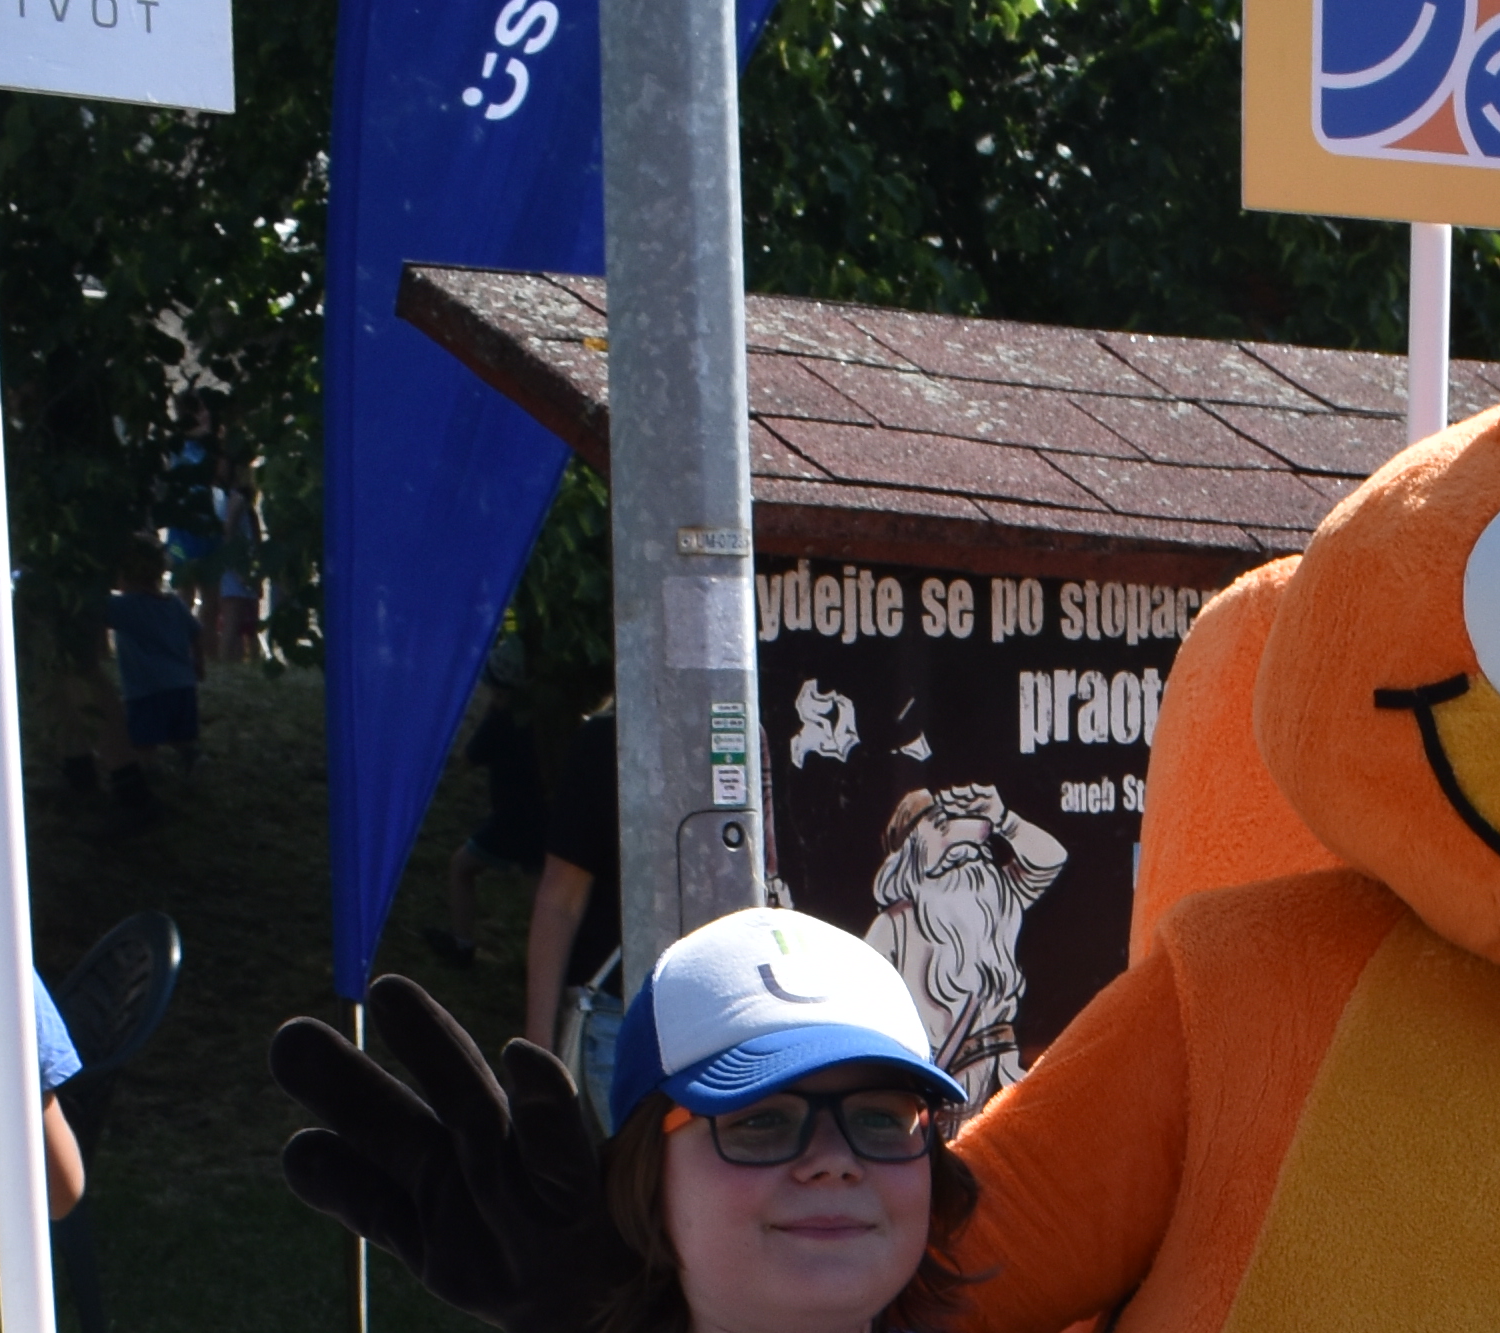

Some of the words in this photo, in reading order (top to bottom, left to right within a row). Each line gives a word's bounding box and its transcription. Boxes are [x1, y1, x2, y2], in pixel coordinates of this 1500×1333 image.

[921, 576, 974, 639] se
[991, 577, 1044, 644] po
[1060, 580, 1215, 646] stopac
[1061, 776, 1115, 814] aneb
